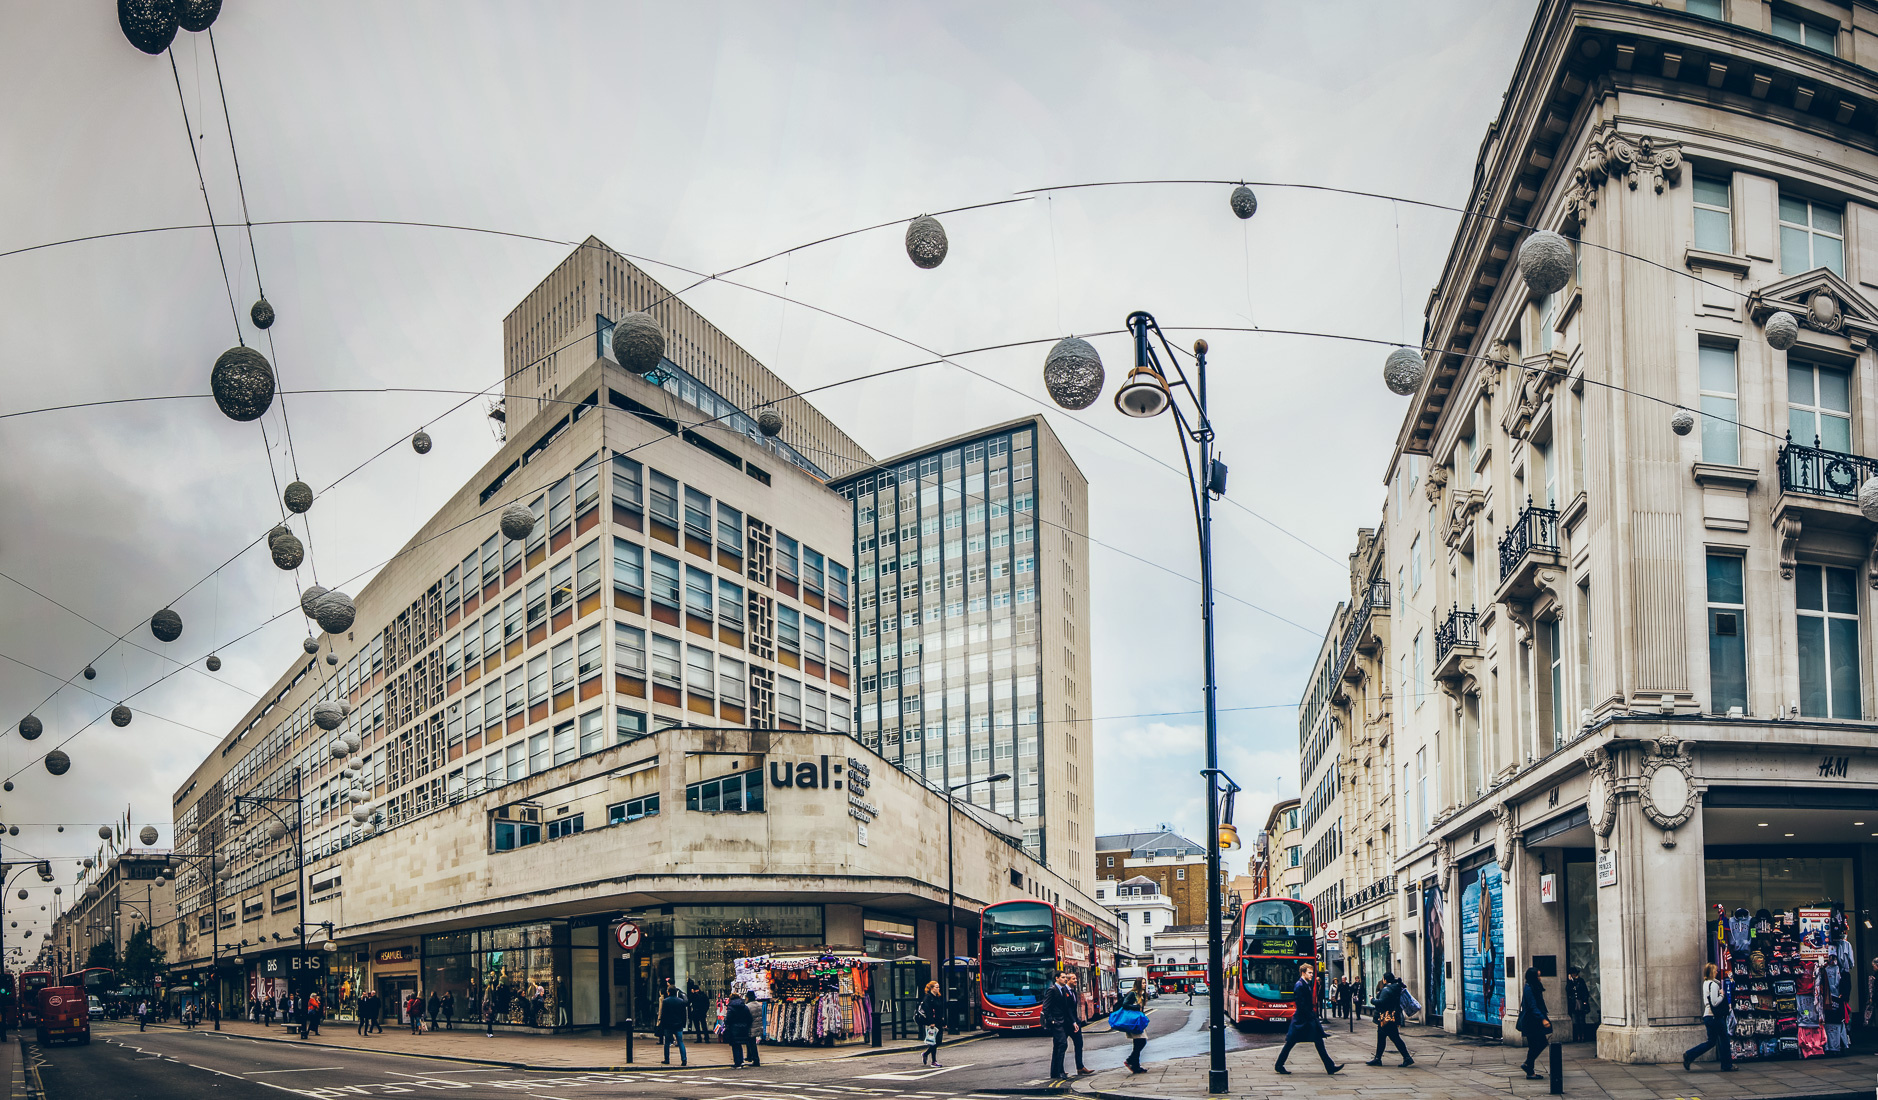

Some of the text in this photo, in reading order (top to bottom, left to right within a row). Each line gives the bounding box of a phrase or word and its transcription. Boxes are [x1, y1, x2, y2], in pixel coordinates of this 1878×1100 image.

[1818, 756, 1849, 778] H&M
[992, 945, 1009, 953] Oxford
[1033, 943, 1040, 952] 7
[267, 959, 278, 972] BHS
